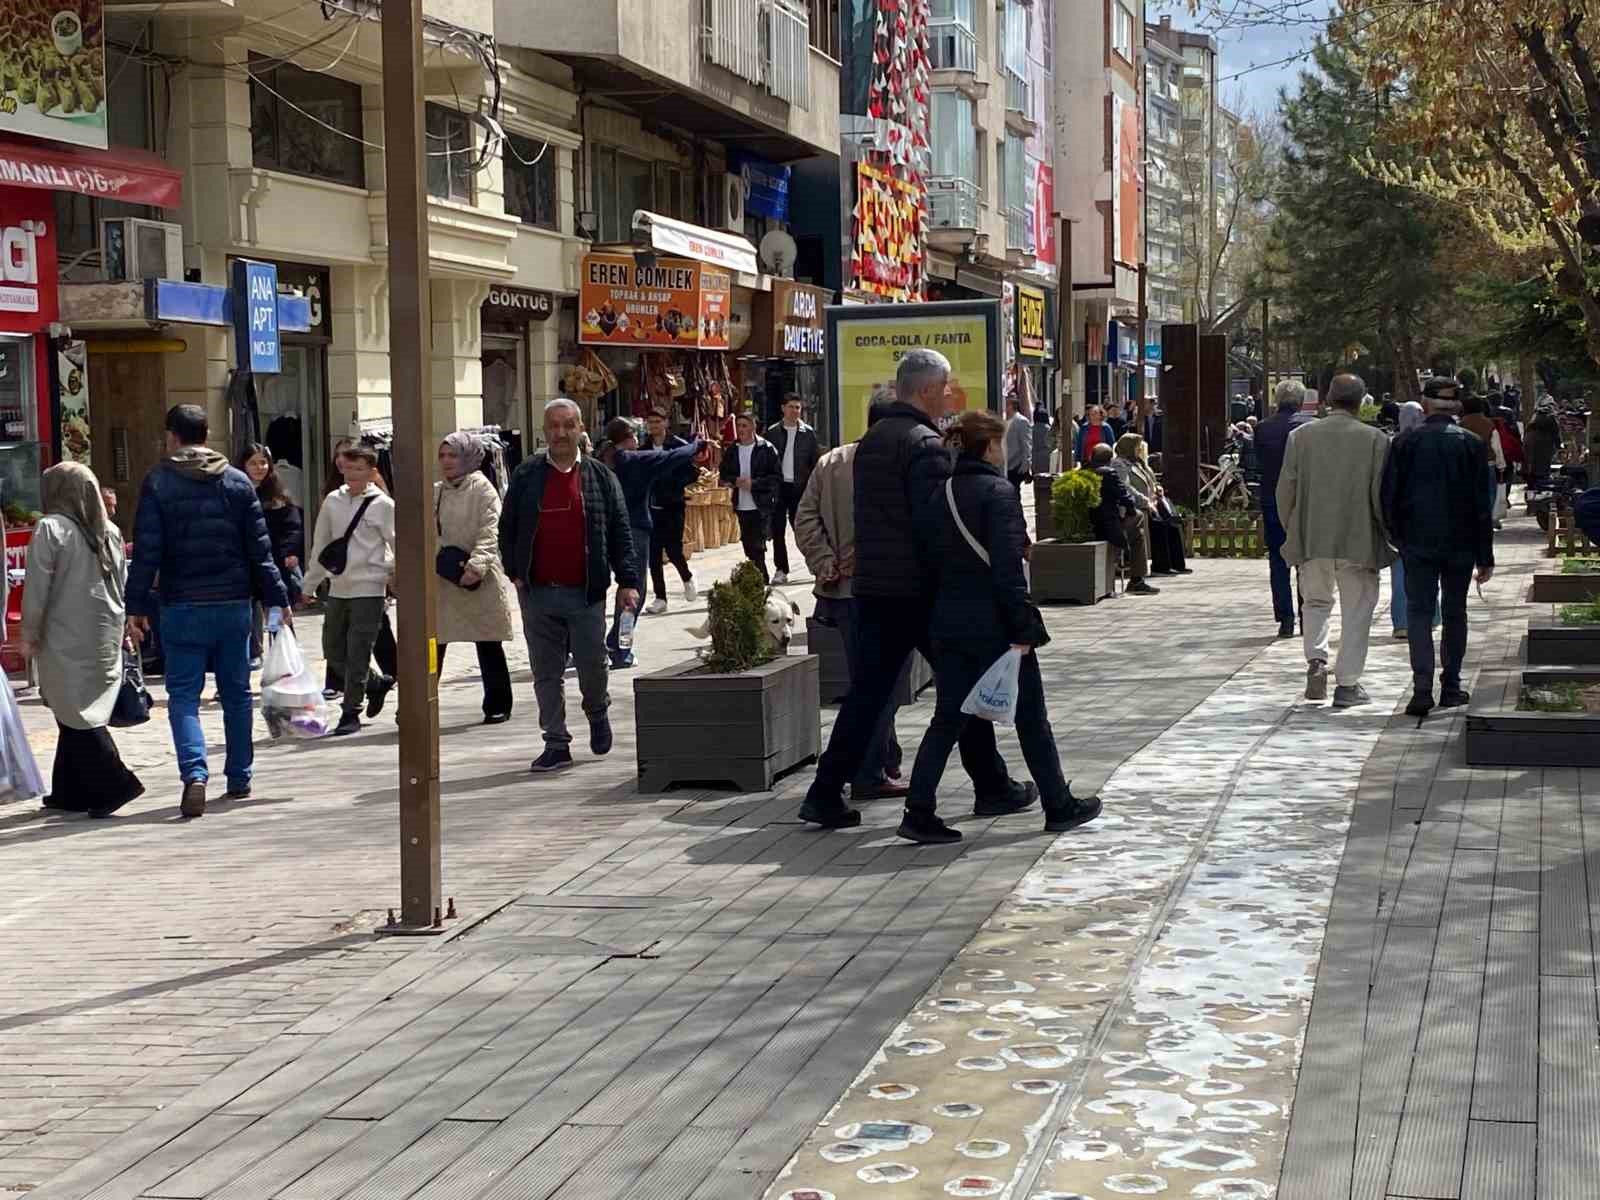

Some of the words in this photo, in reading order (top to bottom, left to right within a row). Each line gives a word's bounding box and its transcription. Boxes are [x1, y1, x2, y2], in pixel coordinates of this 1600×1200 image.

[0, 158, 73, 187] MANLI
[590, 262, 629, 286] EREN
[251, 275, 273, 301] ANA
[793, 290, 816, 319] ARDA
[855, 335, 922, 347] COCA-COLA
[934, 332, 972, 345] FANTA
